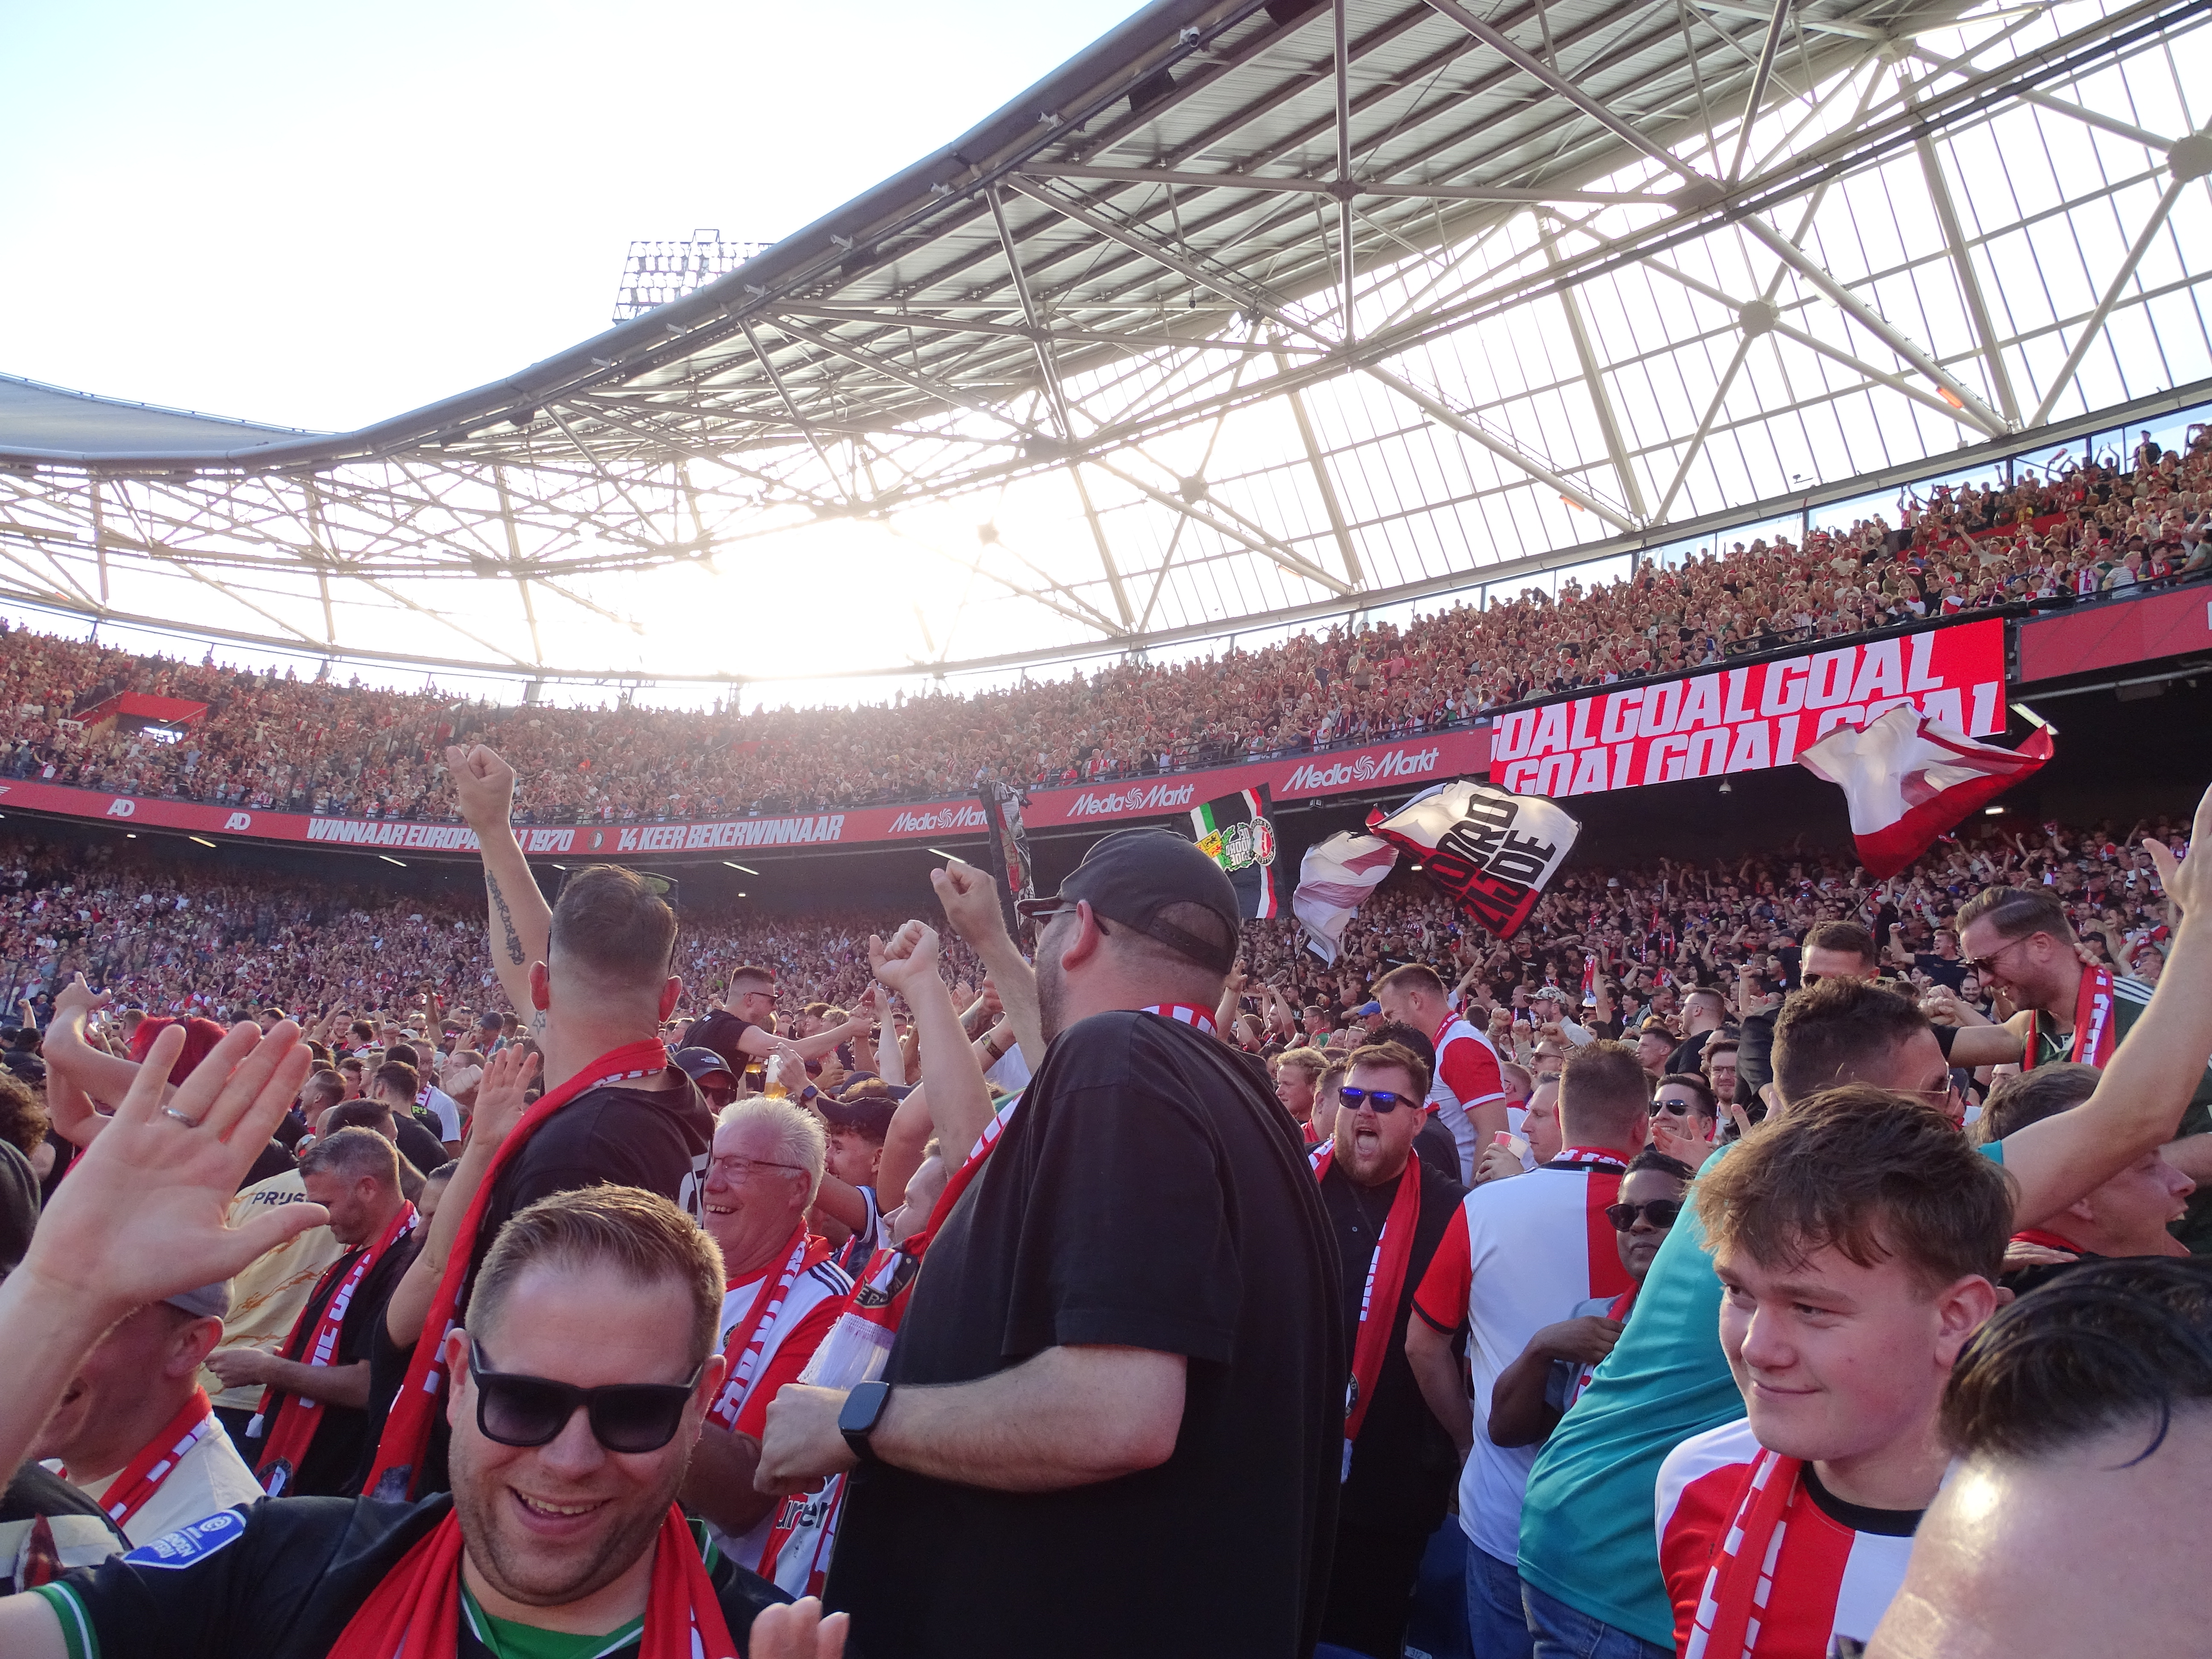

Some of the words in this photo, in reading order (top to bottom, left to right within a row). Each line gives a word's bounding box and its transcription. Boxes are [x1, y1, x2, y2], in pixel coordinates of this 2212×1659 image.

[1760, 631, 1943, 717] GOAL
[107, 799, 135, 817] AD
[224, 812, 251, 830] AD
[307, 818, 410, 845] WINNAAR
[527, 829, 575, 851] 1970
[617, 828, 639, 851] 14
[637, 825, 687, 850] KEER
[684, 815, 845, 848] BEKERWINNAAR
